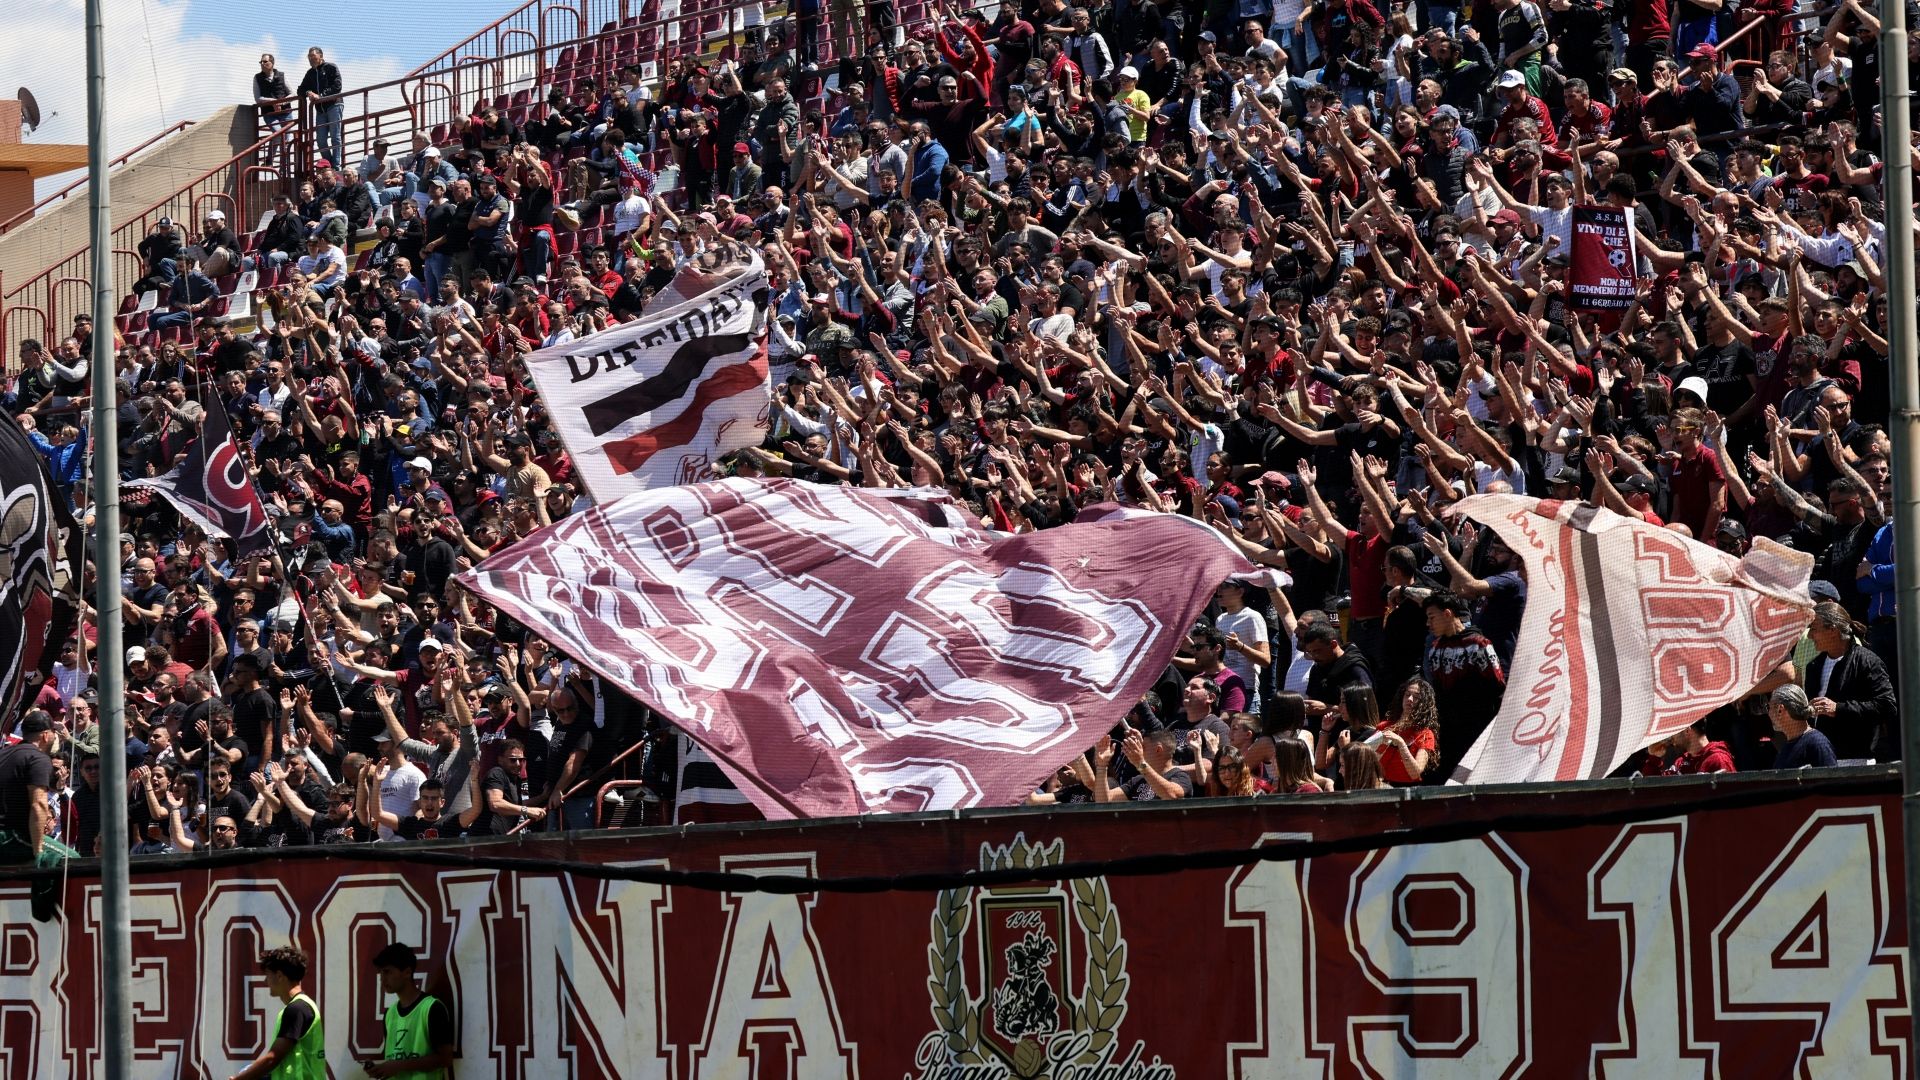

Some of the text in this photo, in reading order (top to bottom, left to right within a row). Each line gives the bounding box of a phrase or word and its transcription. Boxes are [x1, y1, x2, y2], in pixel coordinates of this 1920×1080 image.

[1577, 224, 1603, 235] VIVO
[1605, 226, 1616, 236] DI
[1603, 236, 1623, 247] CHE
[1600, 278, 1618, 287] NON
[1572, 284, 1617, 295] NEMMENO
[1005, 910, 1042, 928] 1914
[1224, 804, 1912, 1080] 1914
[905, 1031, 1176, 1080] Reggio Calabria
